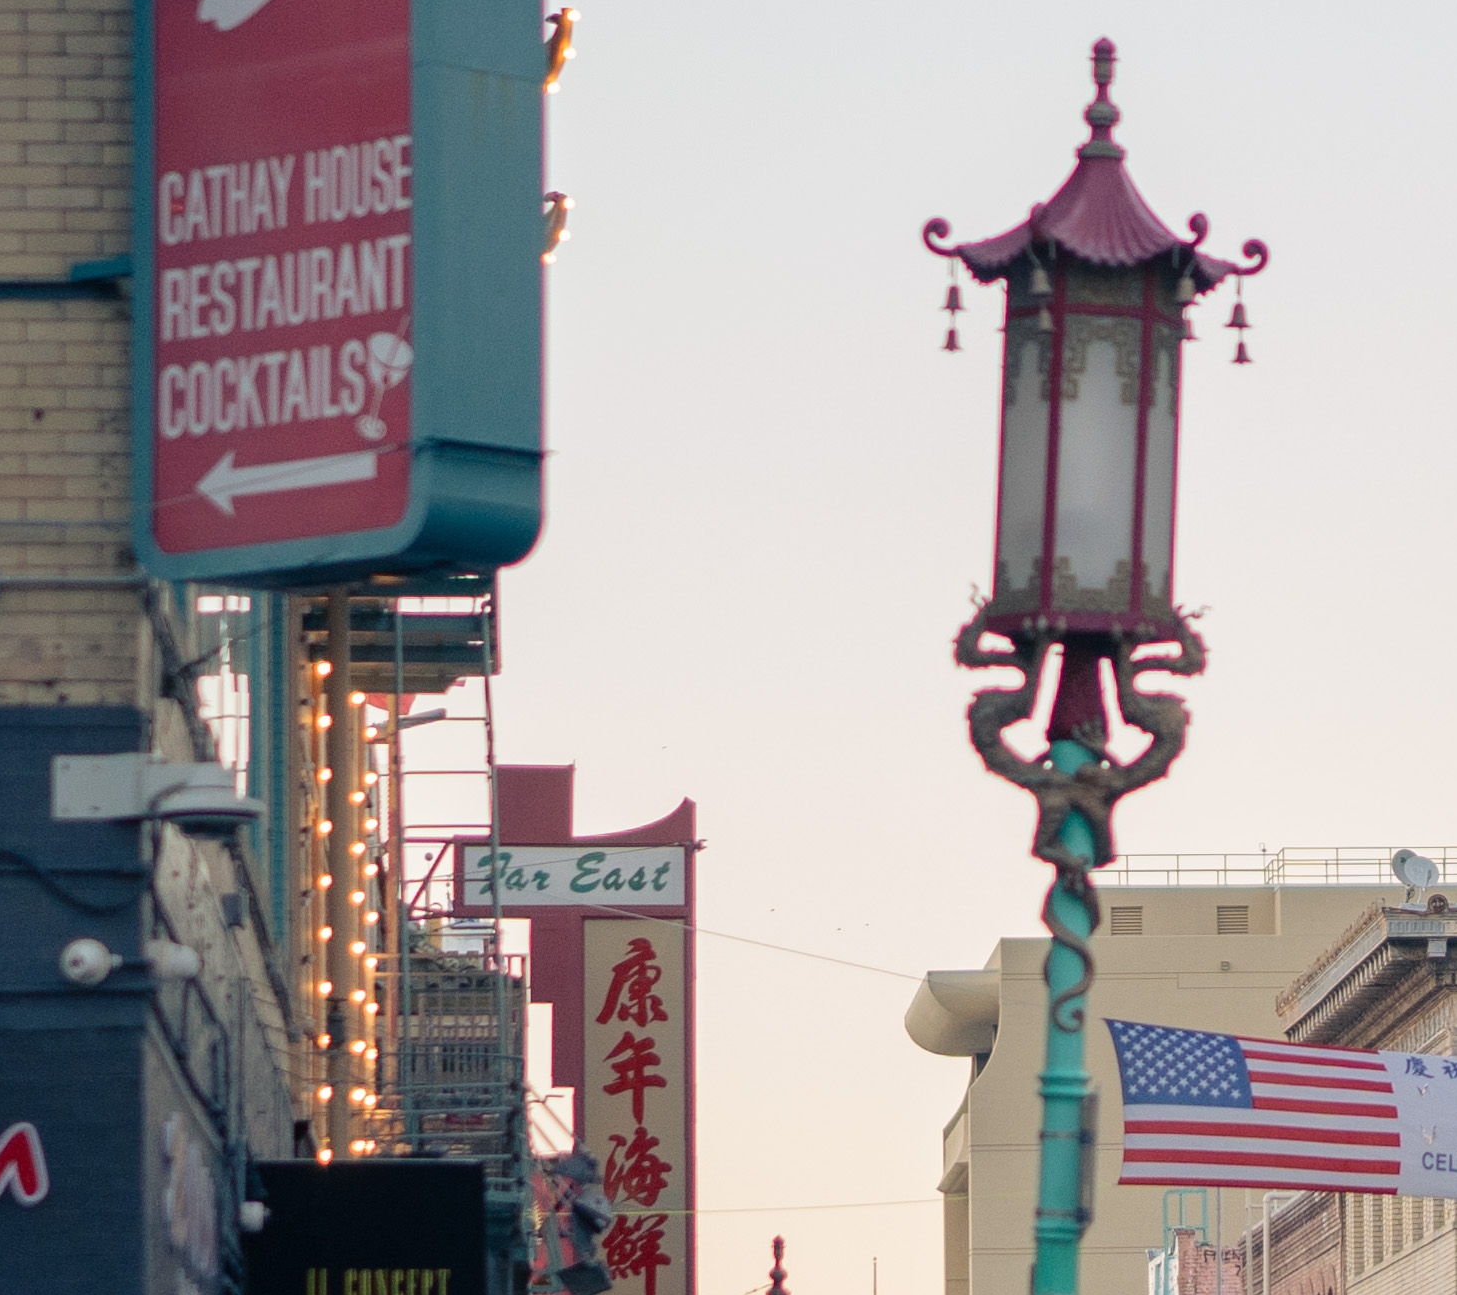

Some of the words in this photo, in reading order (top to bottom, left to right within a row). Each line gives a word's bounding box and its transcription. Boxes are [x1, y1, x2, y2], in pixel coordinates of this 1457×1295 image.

[158, 153, 296, 245] CATHAY
[304, 135, 414, 225] HOUSE
[160, 235, 411, 342] RESTAURANT
[160, 340, 367, 440] COCKTAILS
[477, 851, 551, 894] Far
[570, 851, 672, 894] East
